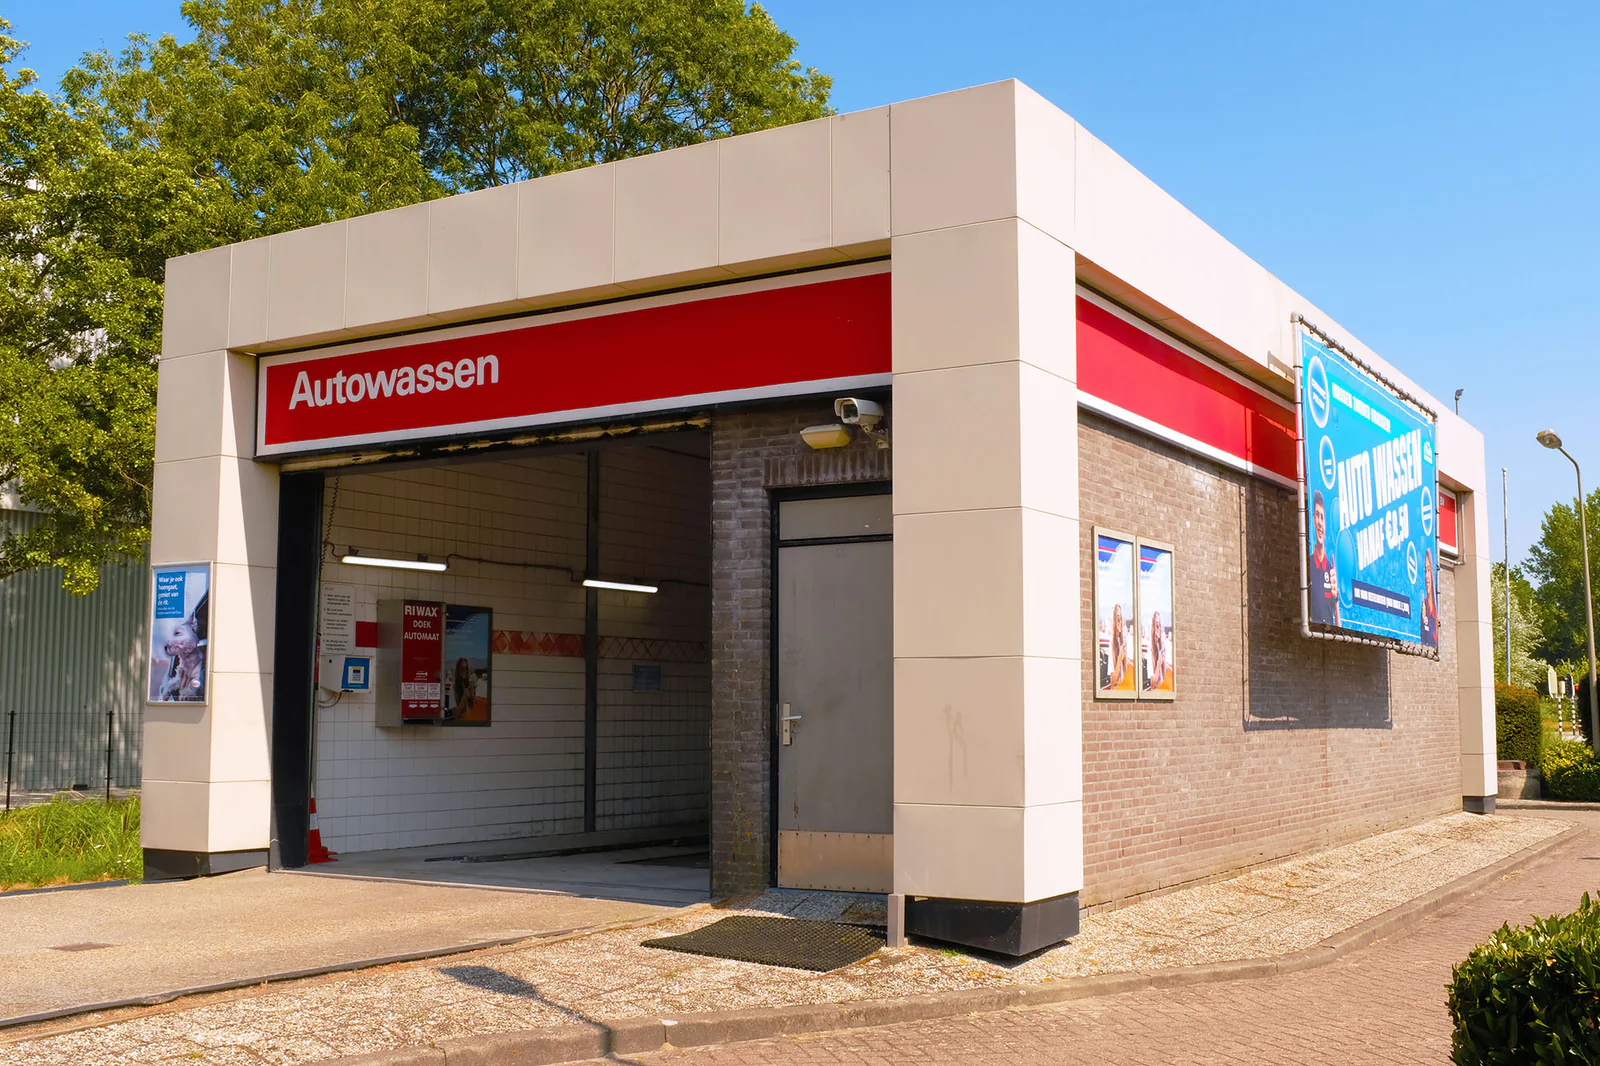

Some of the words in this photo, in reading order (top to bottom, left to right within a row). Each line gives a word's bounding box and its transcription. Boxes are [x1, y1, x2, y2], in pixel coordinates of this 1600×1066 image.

[288, 354, 499, 410] Autowassen
[1337, 450, 1373, 531] AUTO
[1372, 429, 1423, 510] WASSEN
[1356, 517, 1385, 571] VANAF
[1385, 503, 1410, 550] €8,50
[404, 605, 438, 617] RIWAX
[412, 620, 432, 629] DOEK
[403, 631, 440, 641] AUTOMAAT
